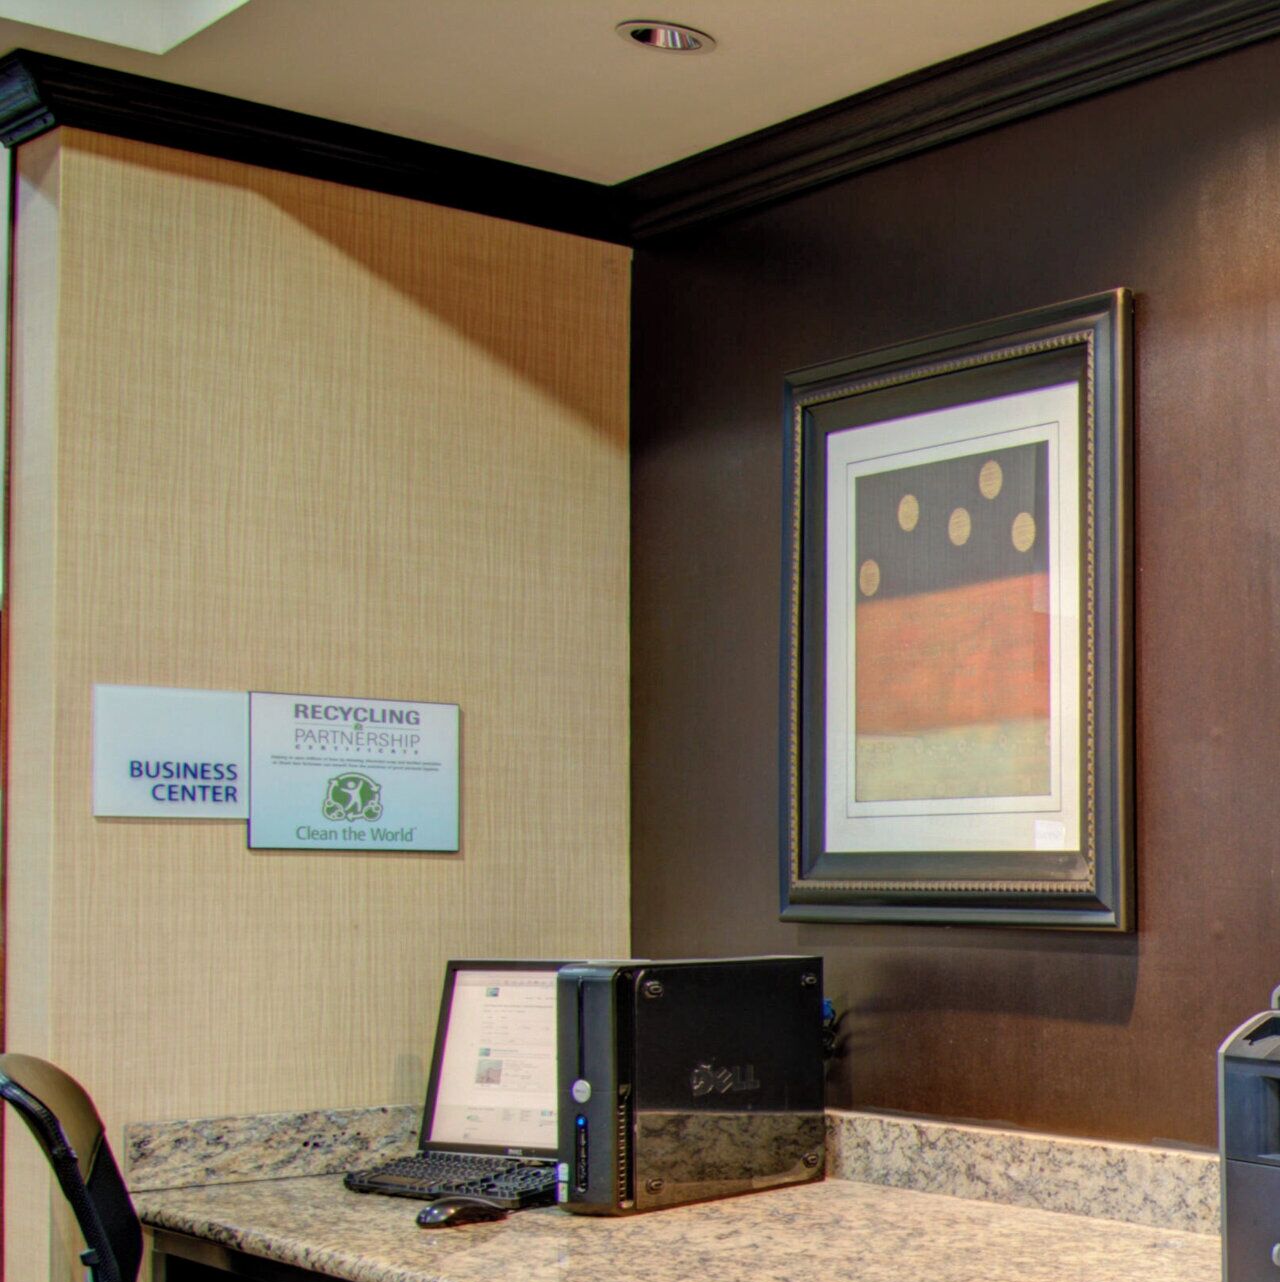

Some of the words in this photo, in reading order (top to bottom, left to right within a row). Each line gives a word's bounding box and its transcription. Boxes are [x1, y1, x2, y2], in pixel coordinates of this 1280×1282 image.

[294, 703, 421, 725] RECYCLING
[295, 728, 421, 748] PARTNERSHIP
[129, 760, 238, 780] BUSINESS
[151, 783, 238, 802] CENTER
[295, 825, 339, 841] Clean
[342, 827, 367, 841] the
[370, 827, 414, 842] World
[692, 1063, 760, 1097] DELL
